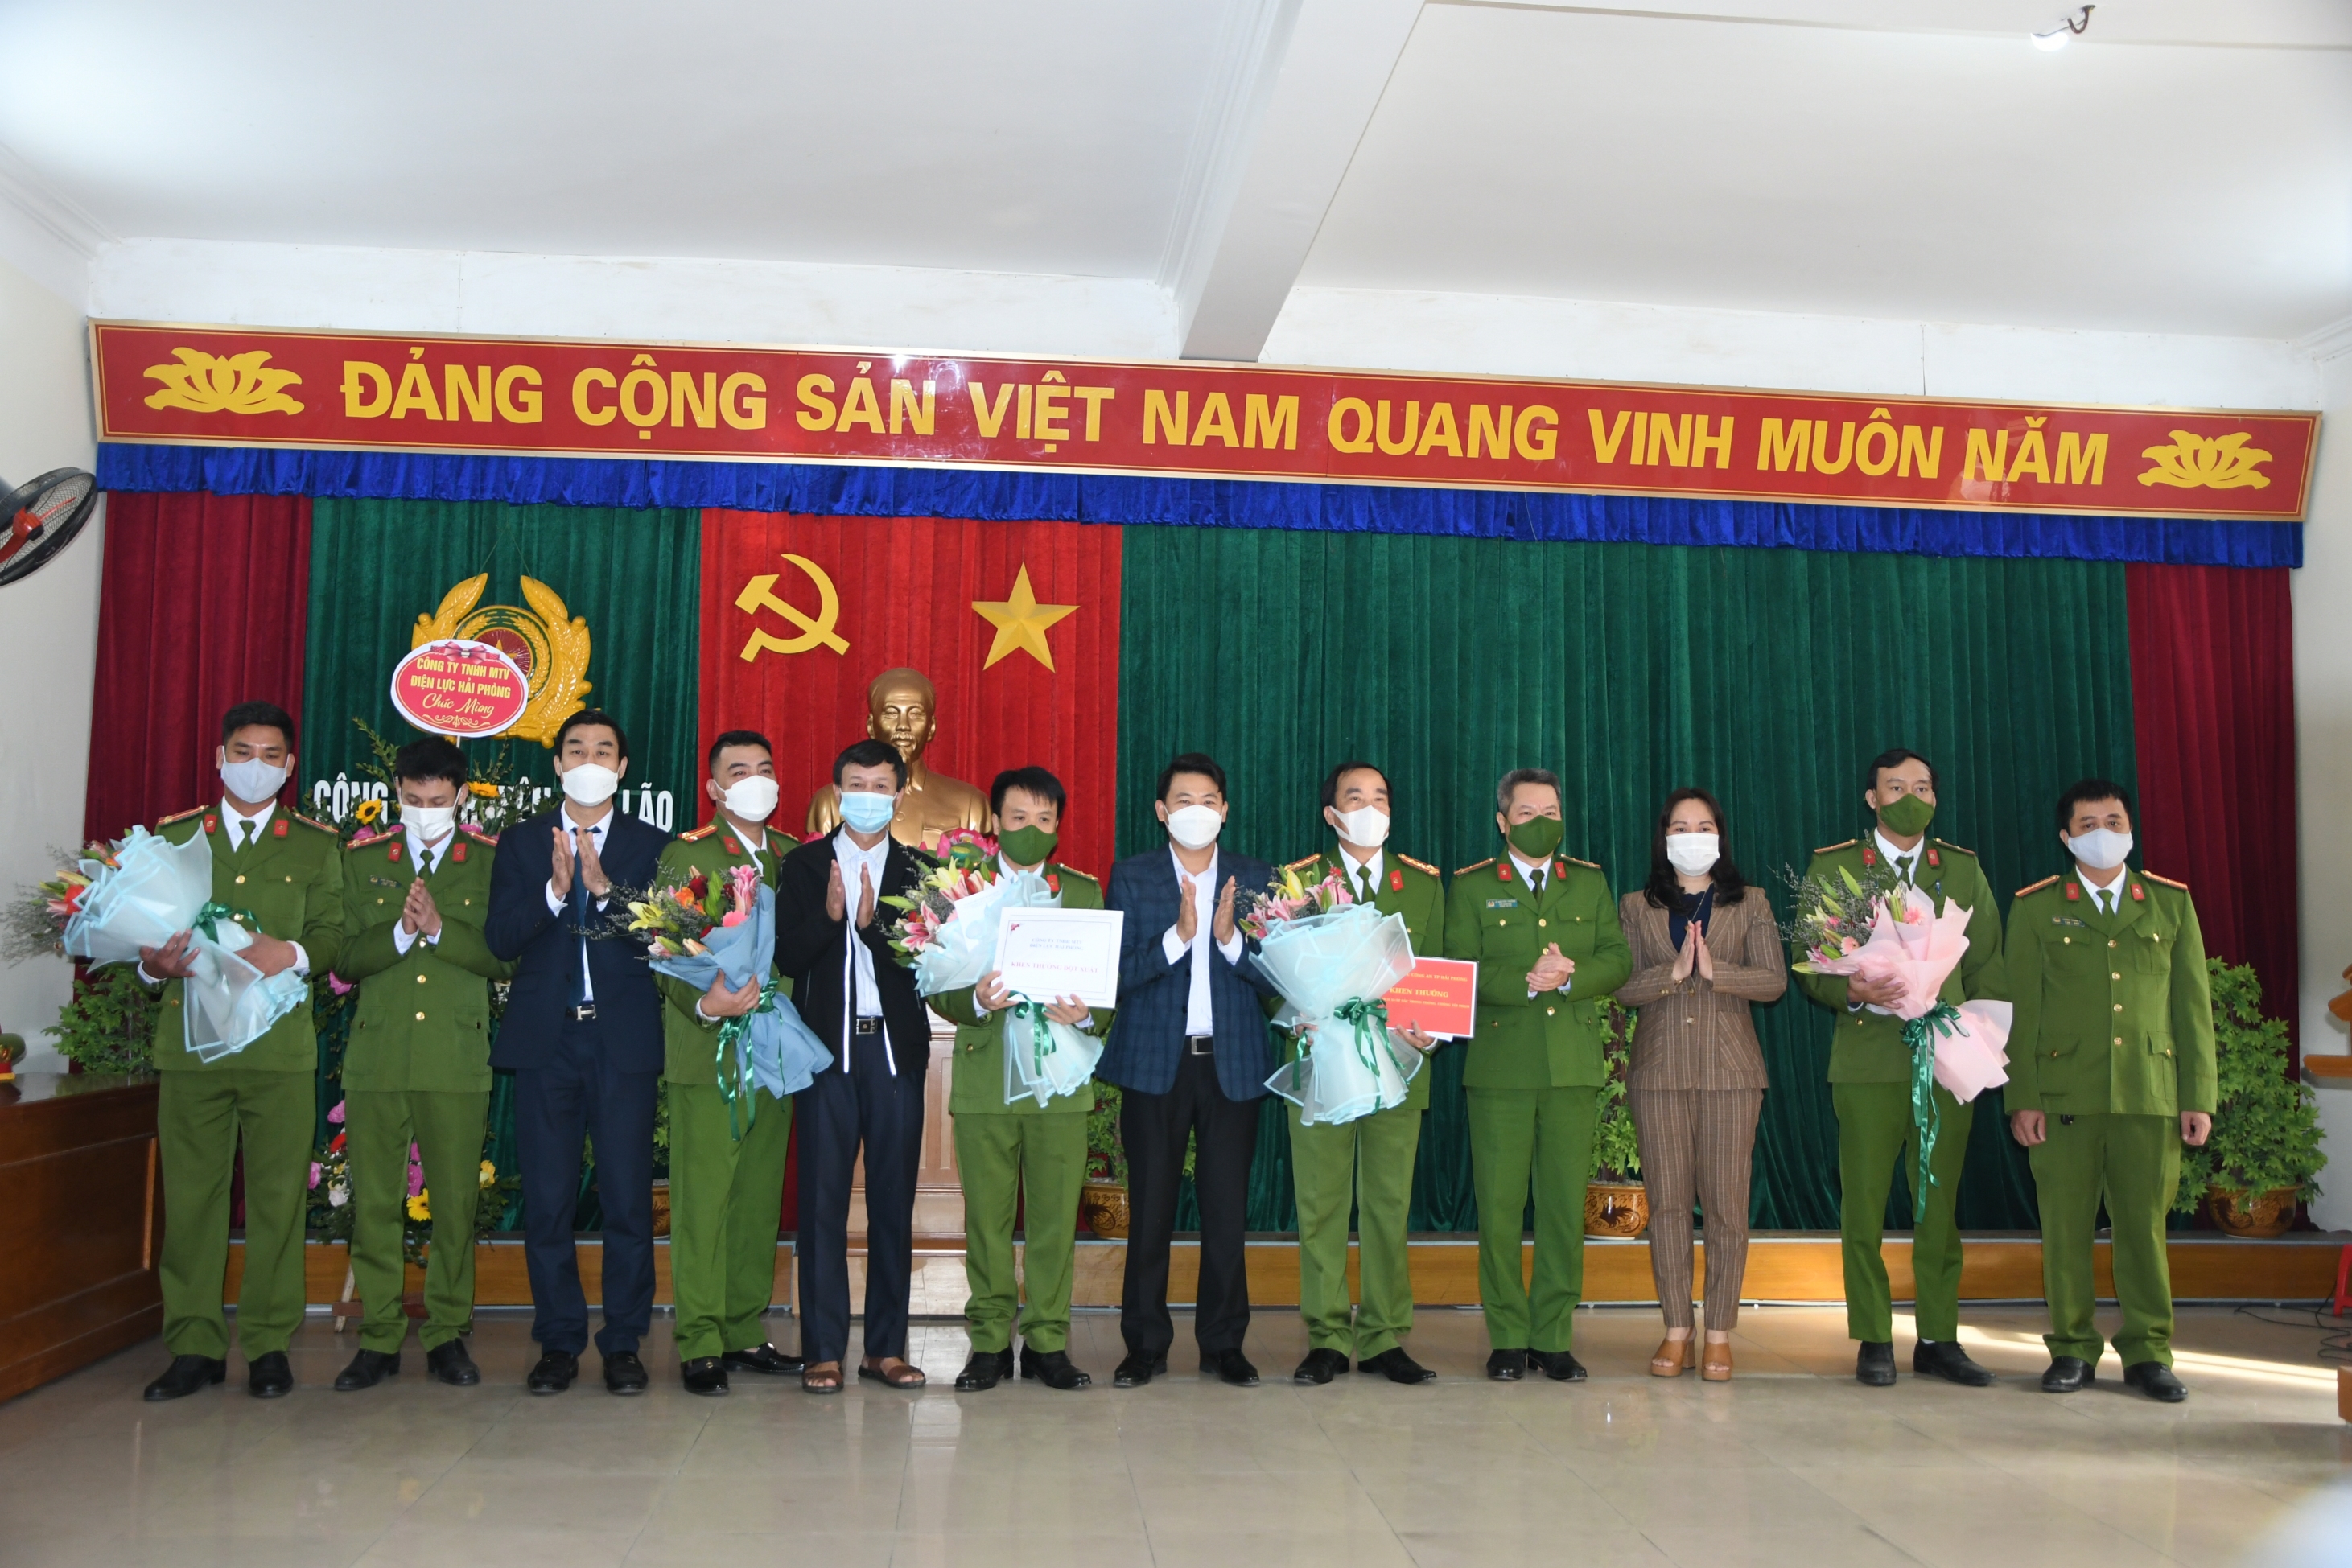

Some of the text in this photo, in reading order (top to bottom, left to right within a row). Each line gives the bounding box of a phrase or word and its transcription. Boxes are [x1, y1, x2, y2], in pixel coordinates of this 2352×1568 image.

[340, 346, 2109, 485] ĐẢNG CỘNG SẢN VIỆT NAM QUANG VINH MUÔN NĂM
[417, 656, 510, 680] CÔNG TY TNHH MTV
[410, 674, 511, 698] ĐIỆN LỰC HẢI PHÒNG
[422, 693, 495, 718] Chúc Mừng
